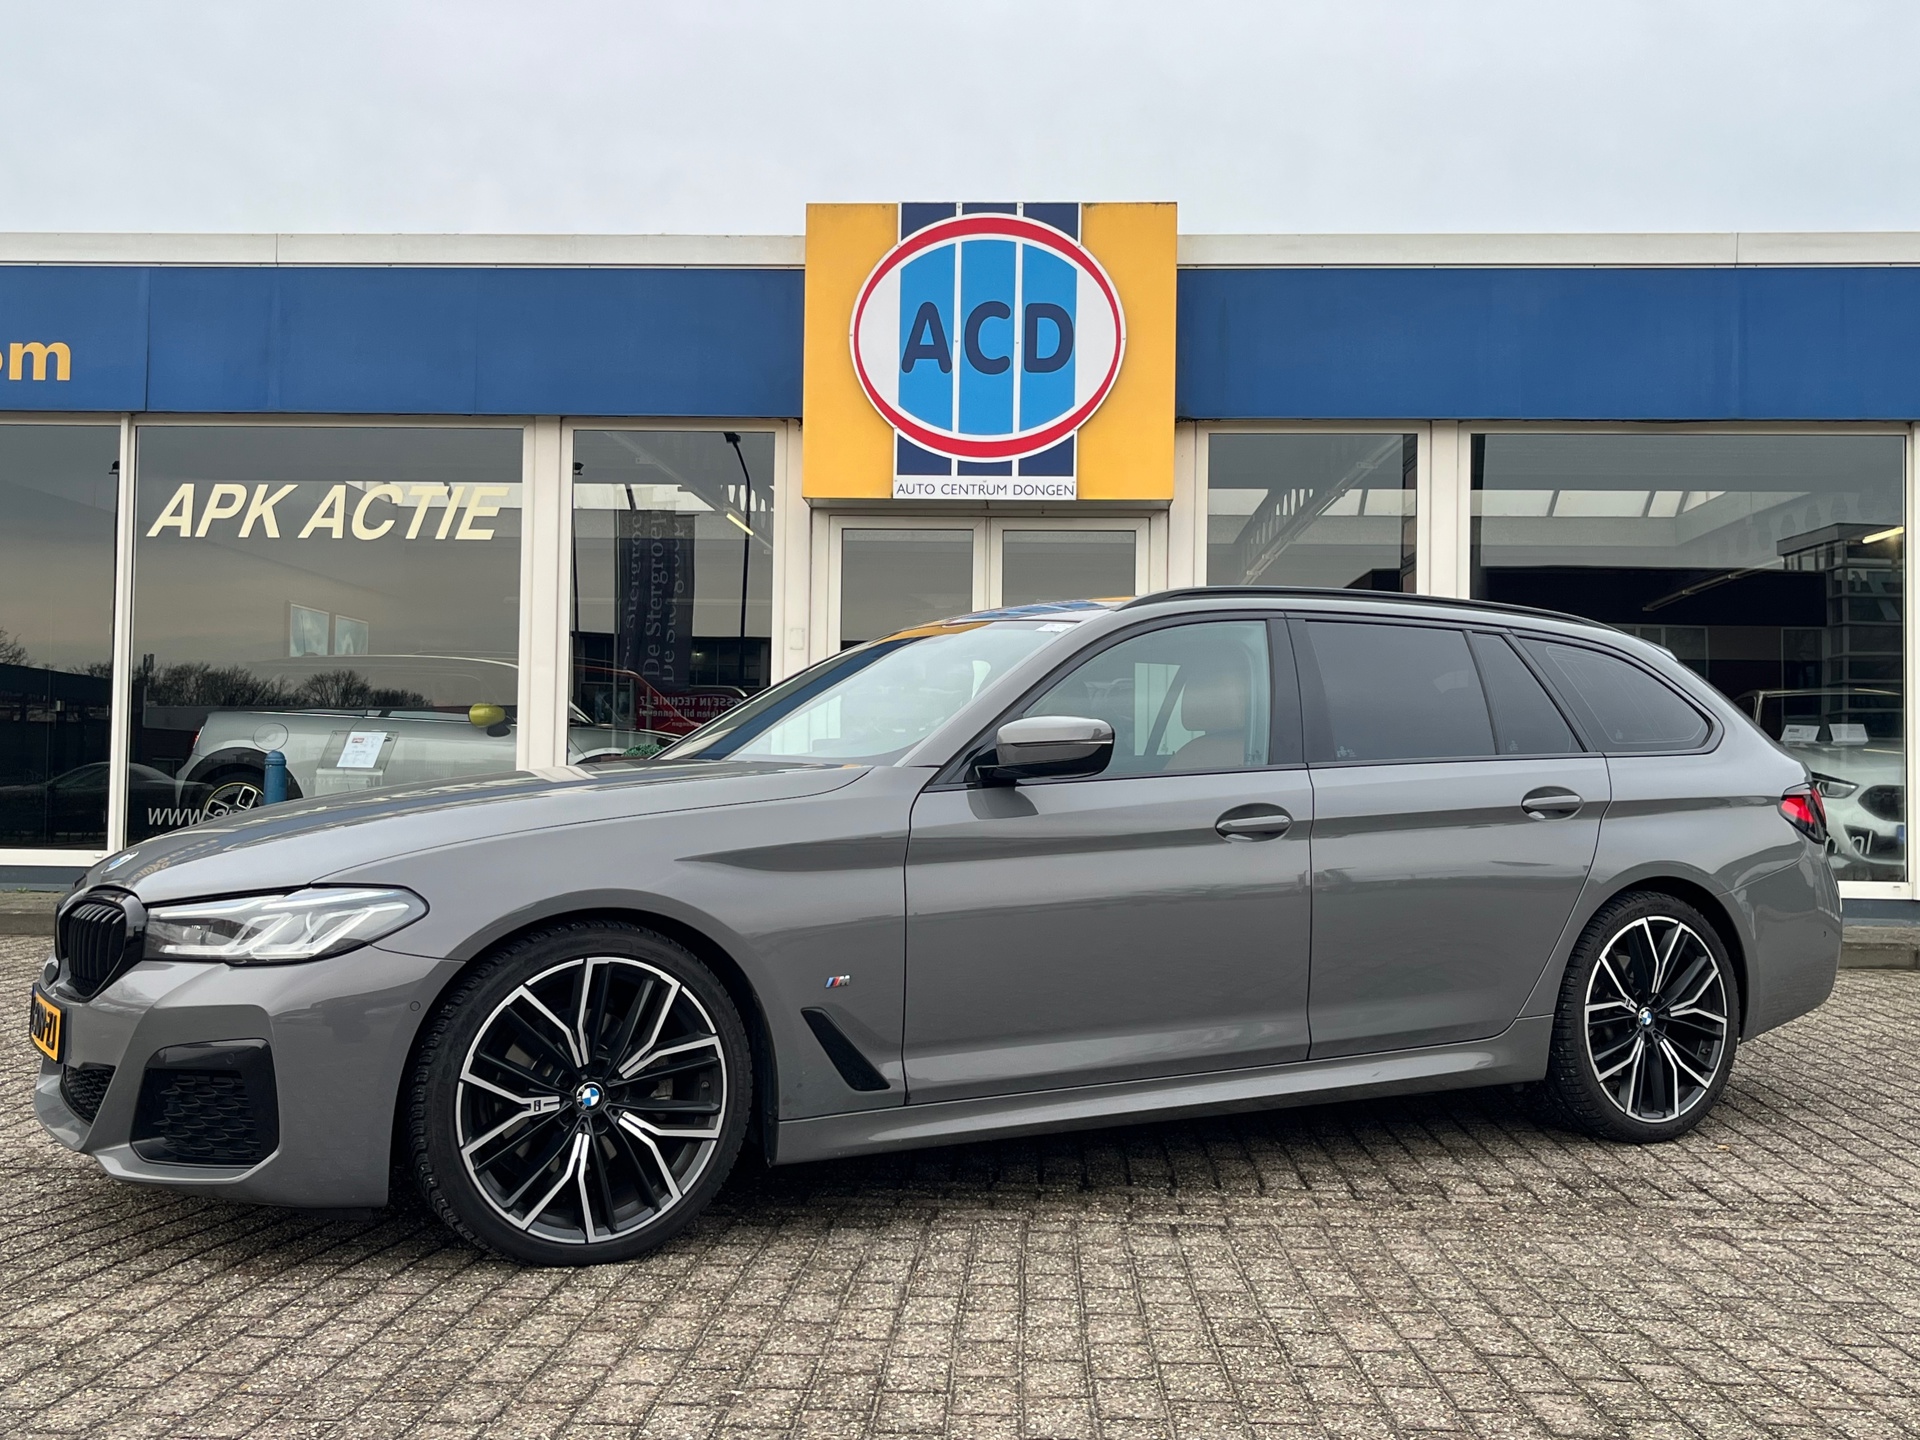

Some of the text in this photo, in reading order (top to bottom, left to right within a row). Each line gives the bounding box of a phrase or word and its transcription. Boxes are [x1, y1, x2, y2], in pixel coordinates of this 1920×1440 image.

[0, 341, 71, 381] m
[901, 301, 1075, 374] ACD
[146, 483, 510, 541] APK ACTIE
[896, 483, 1075, 496] AUTO CENTRUM DONGEN
[643, 510, 669, 677] De Stergroep
